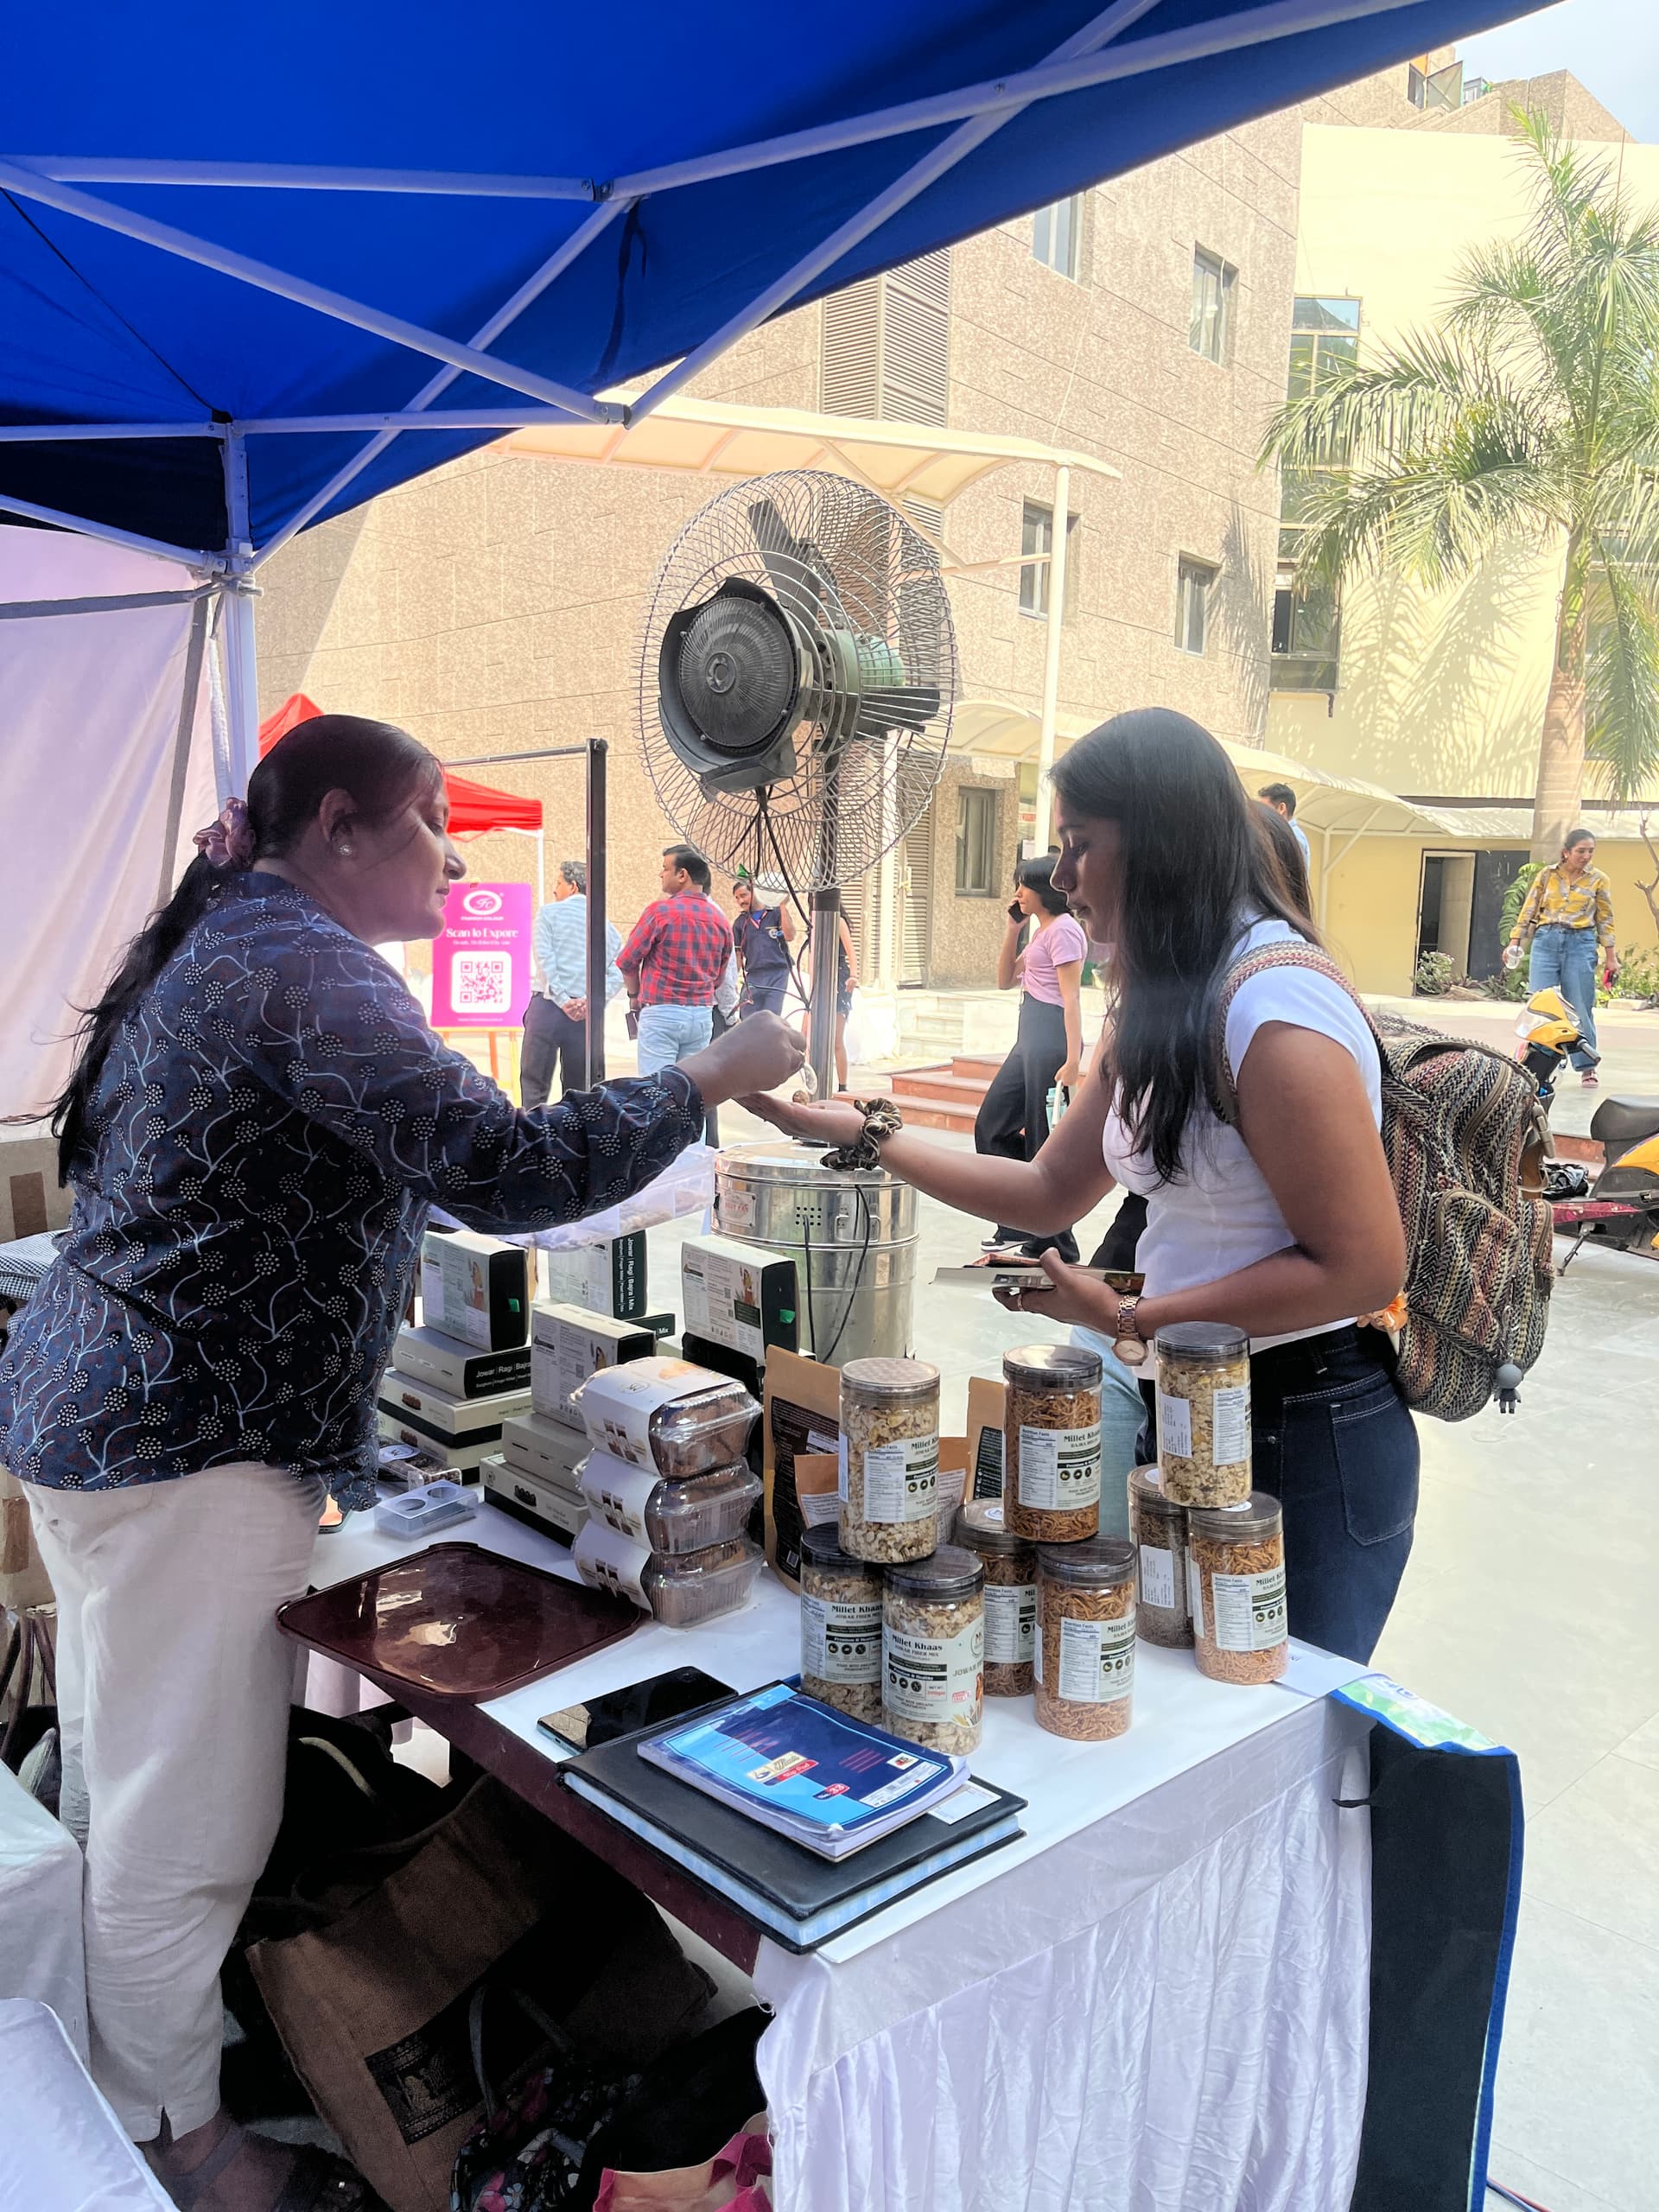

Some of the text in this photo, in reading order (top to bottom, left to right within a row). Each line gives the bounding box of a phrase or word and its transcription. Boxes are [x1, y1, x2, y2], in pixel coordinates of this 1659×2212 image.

[446, 928, 471, 938] Scan
[476, 1369, 495, 1378] Jowar
[499, 1365, 512, 1374] Ragi
[1064, 1434, 1086, 1443] Millet
[911, 1440, 929, 1451] Millet
[1255, 1577, 1275, 1586] Millet
[831, 1605, 856, 1613] Millet
[1107, 1623, 1126, 1633] Millet
[892, 1634, 943, 1651] Millet Khaas
[953, 1663, 976, 1676] JOWAR
[829, 1783, 846, 1796] 33
